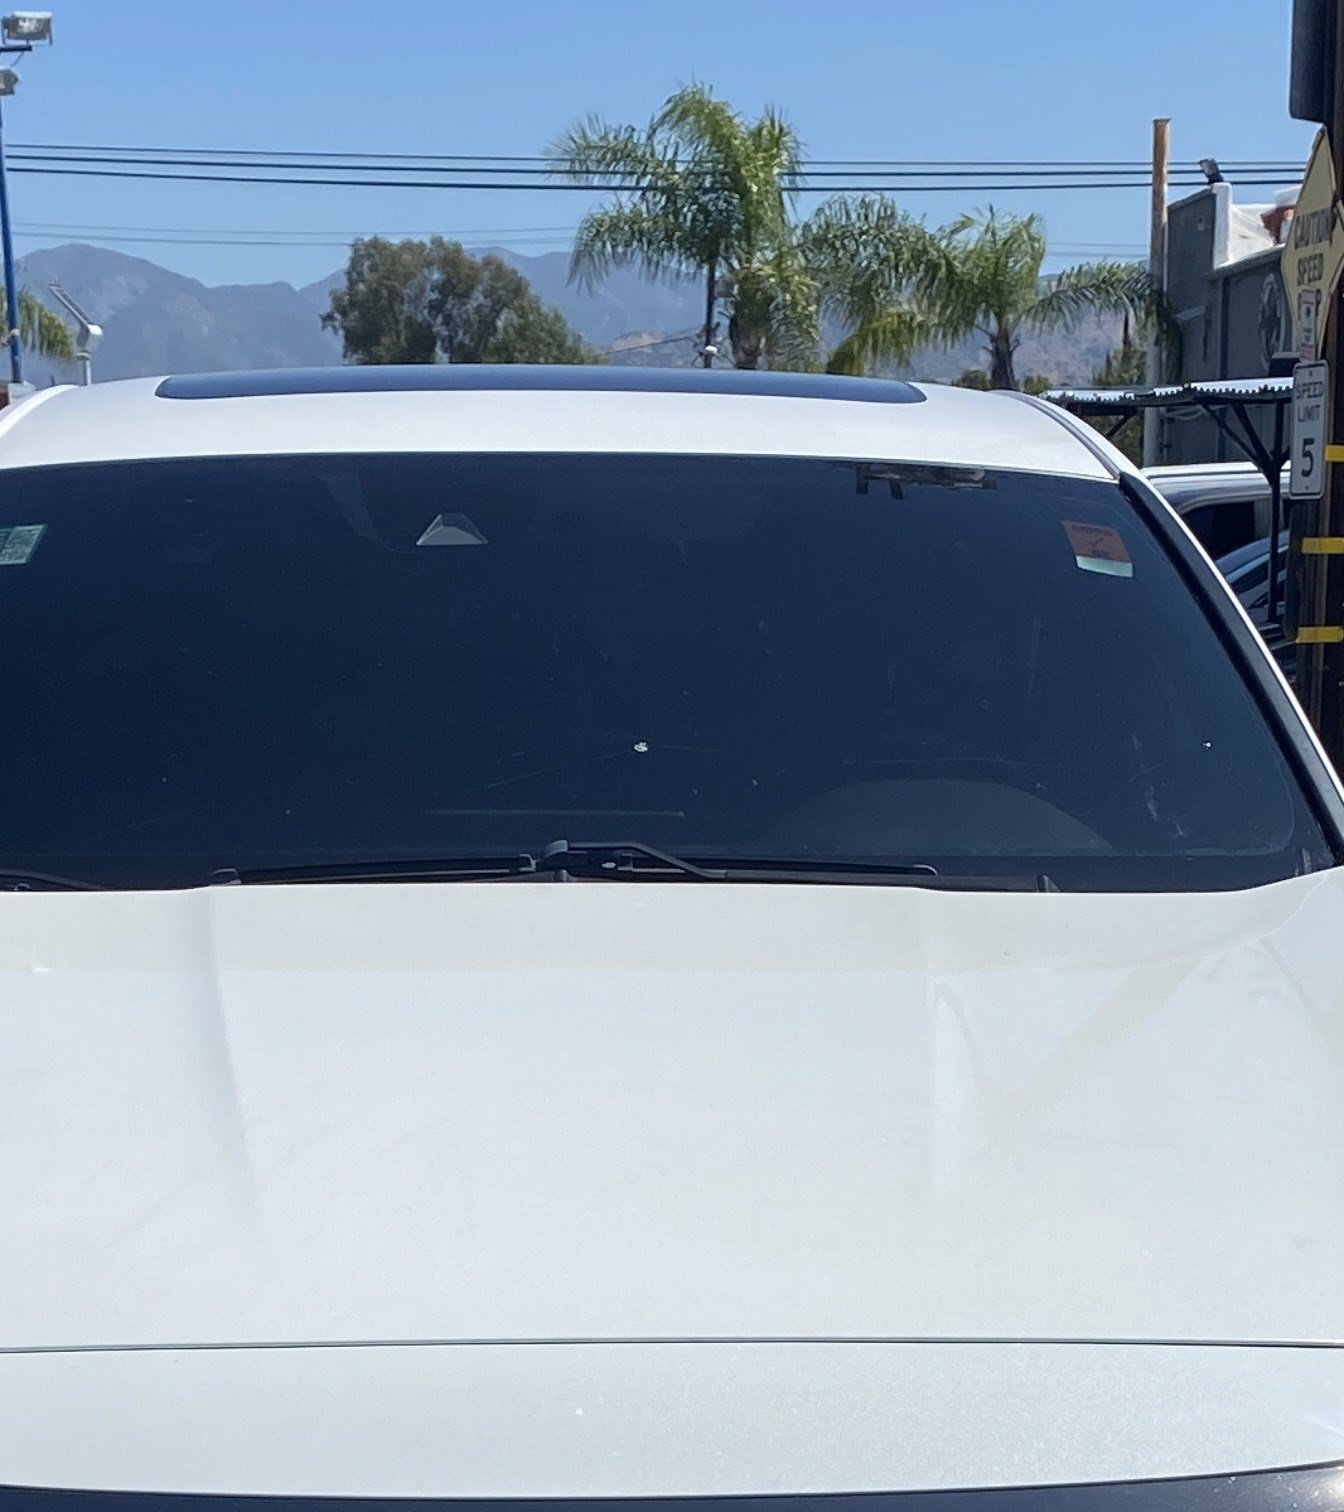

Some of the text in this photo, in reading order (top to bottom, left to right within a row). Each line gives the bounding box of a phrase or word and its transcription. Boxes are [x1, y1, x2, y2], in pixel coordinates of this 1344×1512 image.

[1297, 252, 1324, 286] SPEED
[1295, 381, 1324, 400] SPEED
[1296, 404, 1321, 422] LIMIT
[1300, 436, 1316, 478] 5
